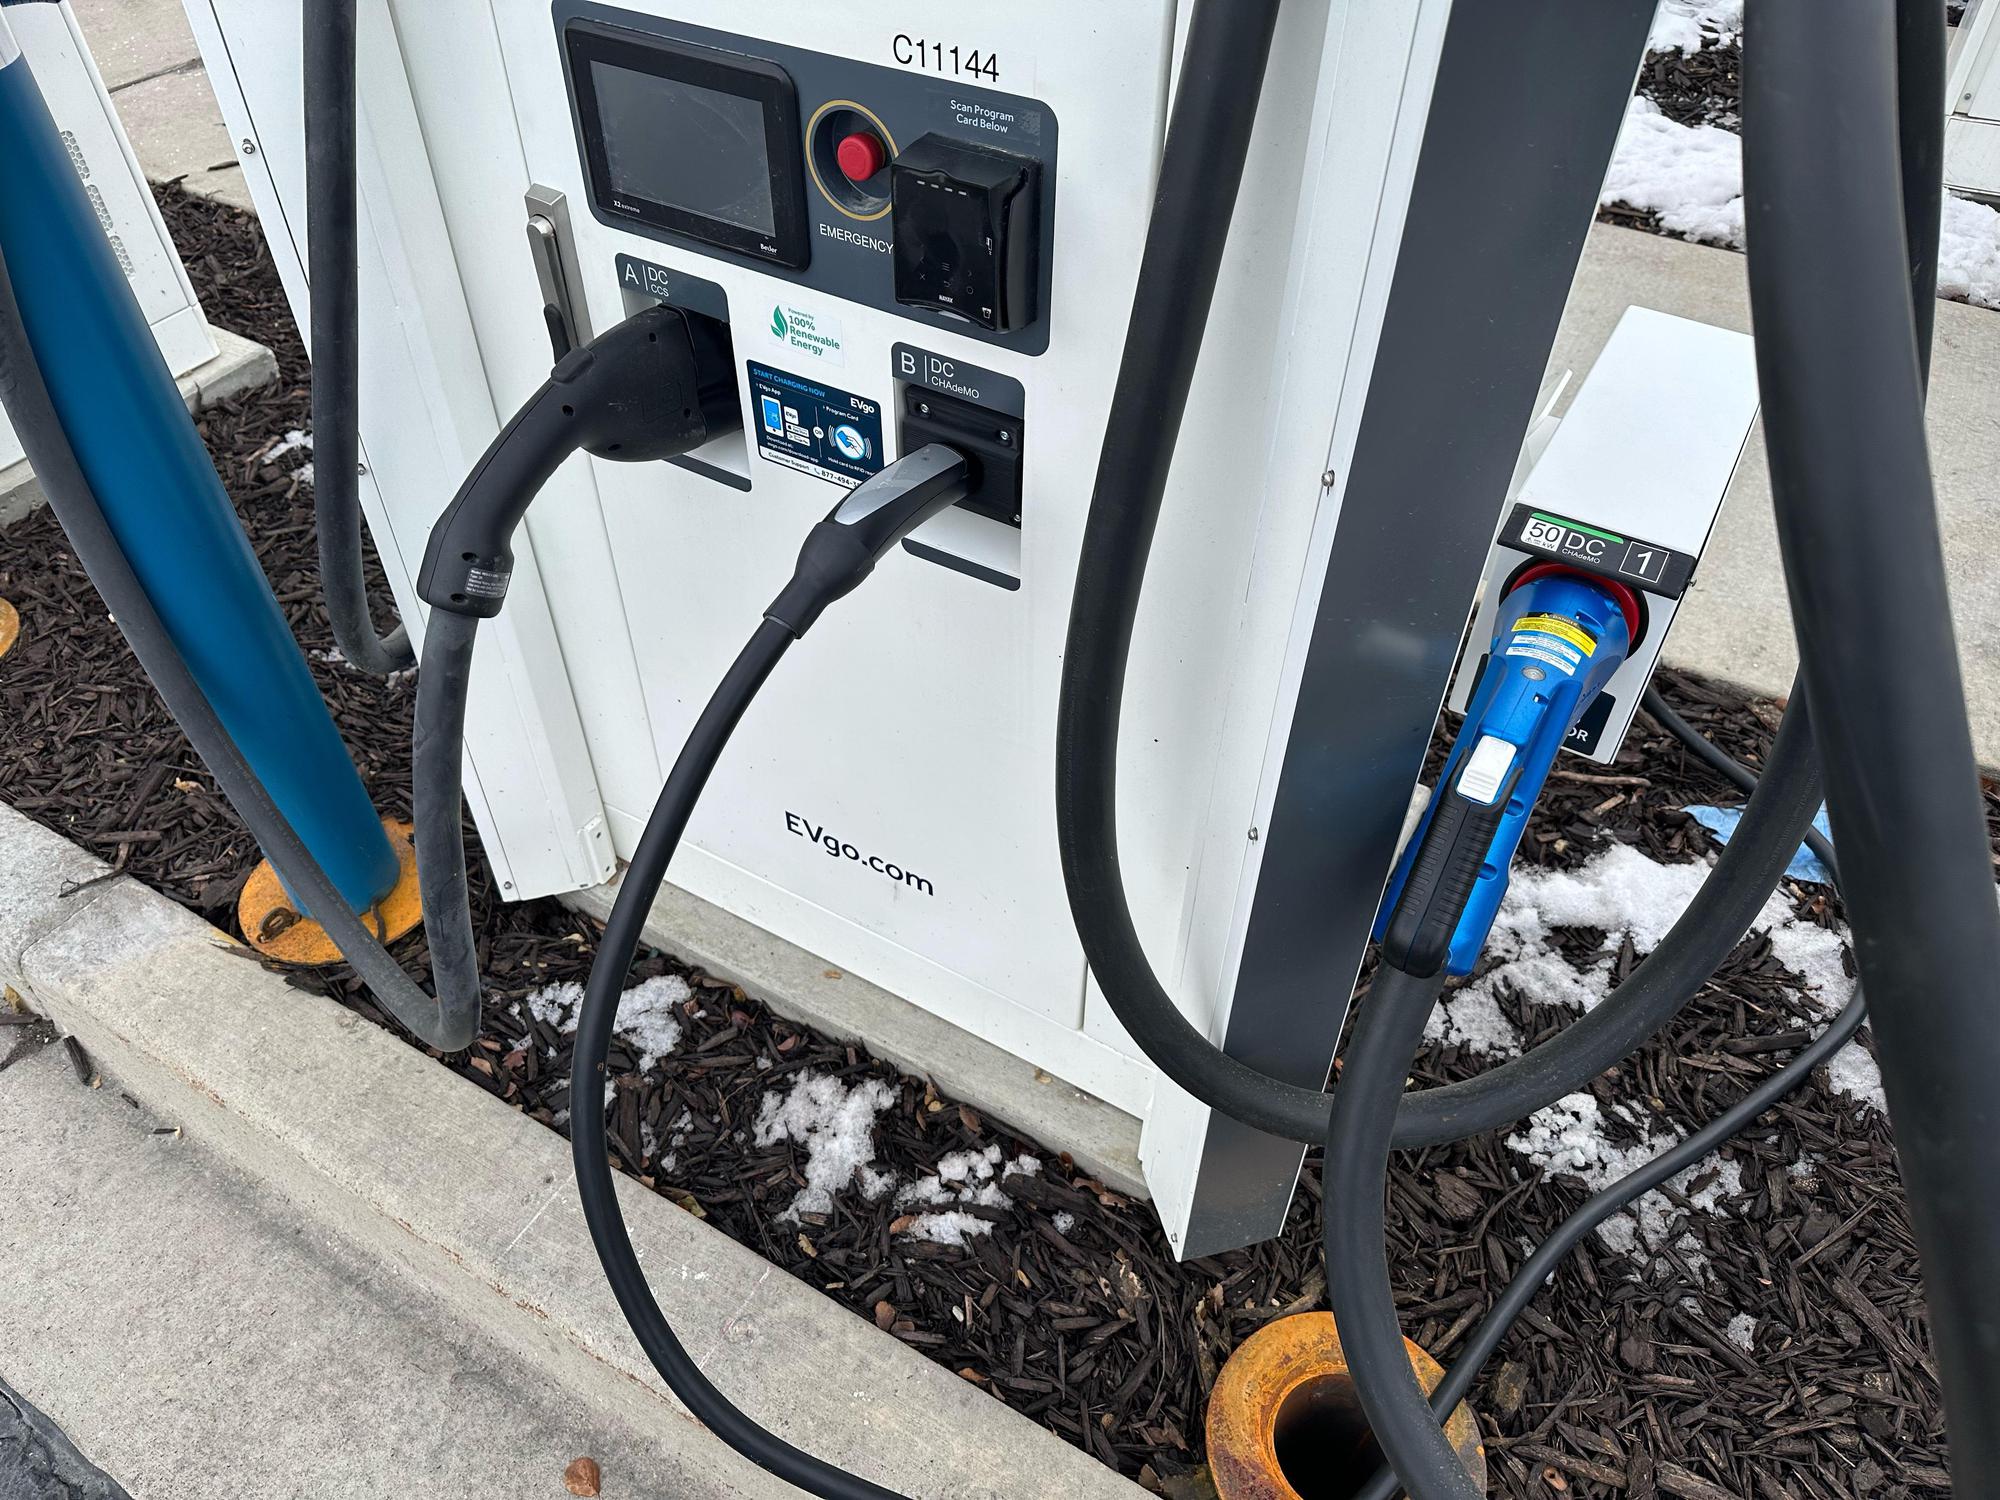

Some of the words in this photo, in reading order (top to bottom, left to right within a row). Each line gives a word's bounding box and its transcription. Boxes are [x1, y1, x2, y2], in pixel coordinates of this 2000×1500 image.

[893, 34, 999, 82] C11144
[950, 99, 973, 113] Scan
[974, 104, 1014, 122] Program
[956, 113, 978, 127] Card
[980, 117, 1008, 133] Below
[819, 223, 894, 254] EMERGENCY
[625, 263, 639, 285] A
[647, 266, 669, 285] DC
[650, 284, 669, 297] CCS
[788, 315, 816, 331] 100%
[789, 325, 840, 350] Renewable
[790, 336, 824, 356] Energy
[901, 351, 916, 375] B
[930, 357, 954, 378] DC
[753, 368, 773, 380] START
[773, 375, 808, 391] CHARGING
[808, 386, 826, 397] NOW
[931, 376, 980, 399] CHAdeMO
[850, 396, 875, 414] EVgo
[846, 413, 859, 422] Card
[1529, 521, 1561, 543] 50
[1564, 532, 1606, 557] DC
[1637, 550, 1653, 575] 1
[1541, 541, 1555, 550] kW
[1561, 548, 1601, 564] CHAdeMO
[785, 810, 934, 897] EVgo.com
